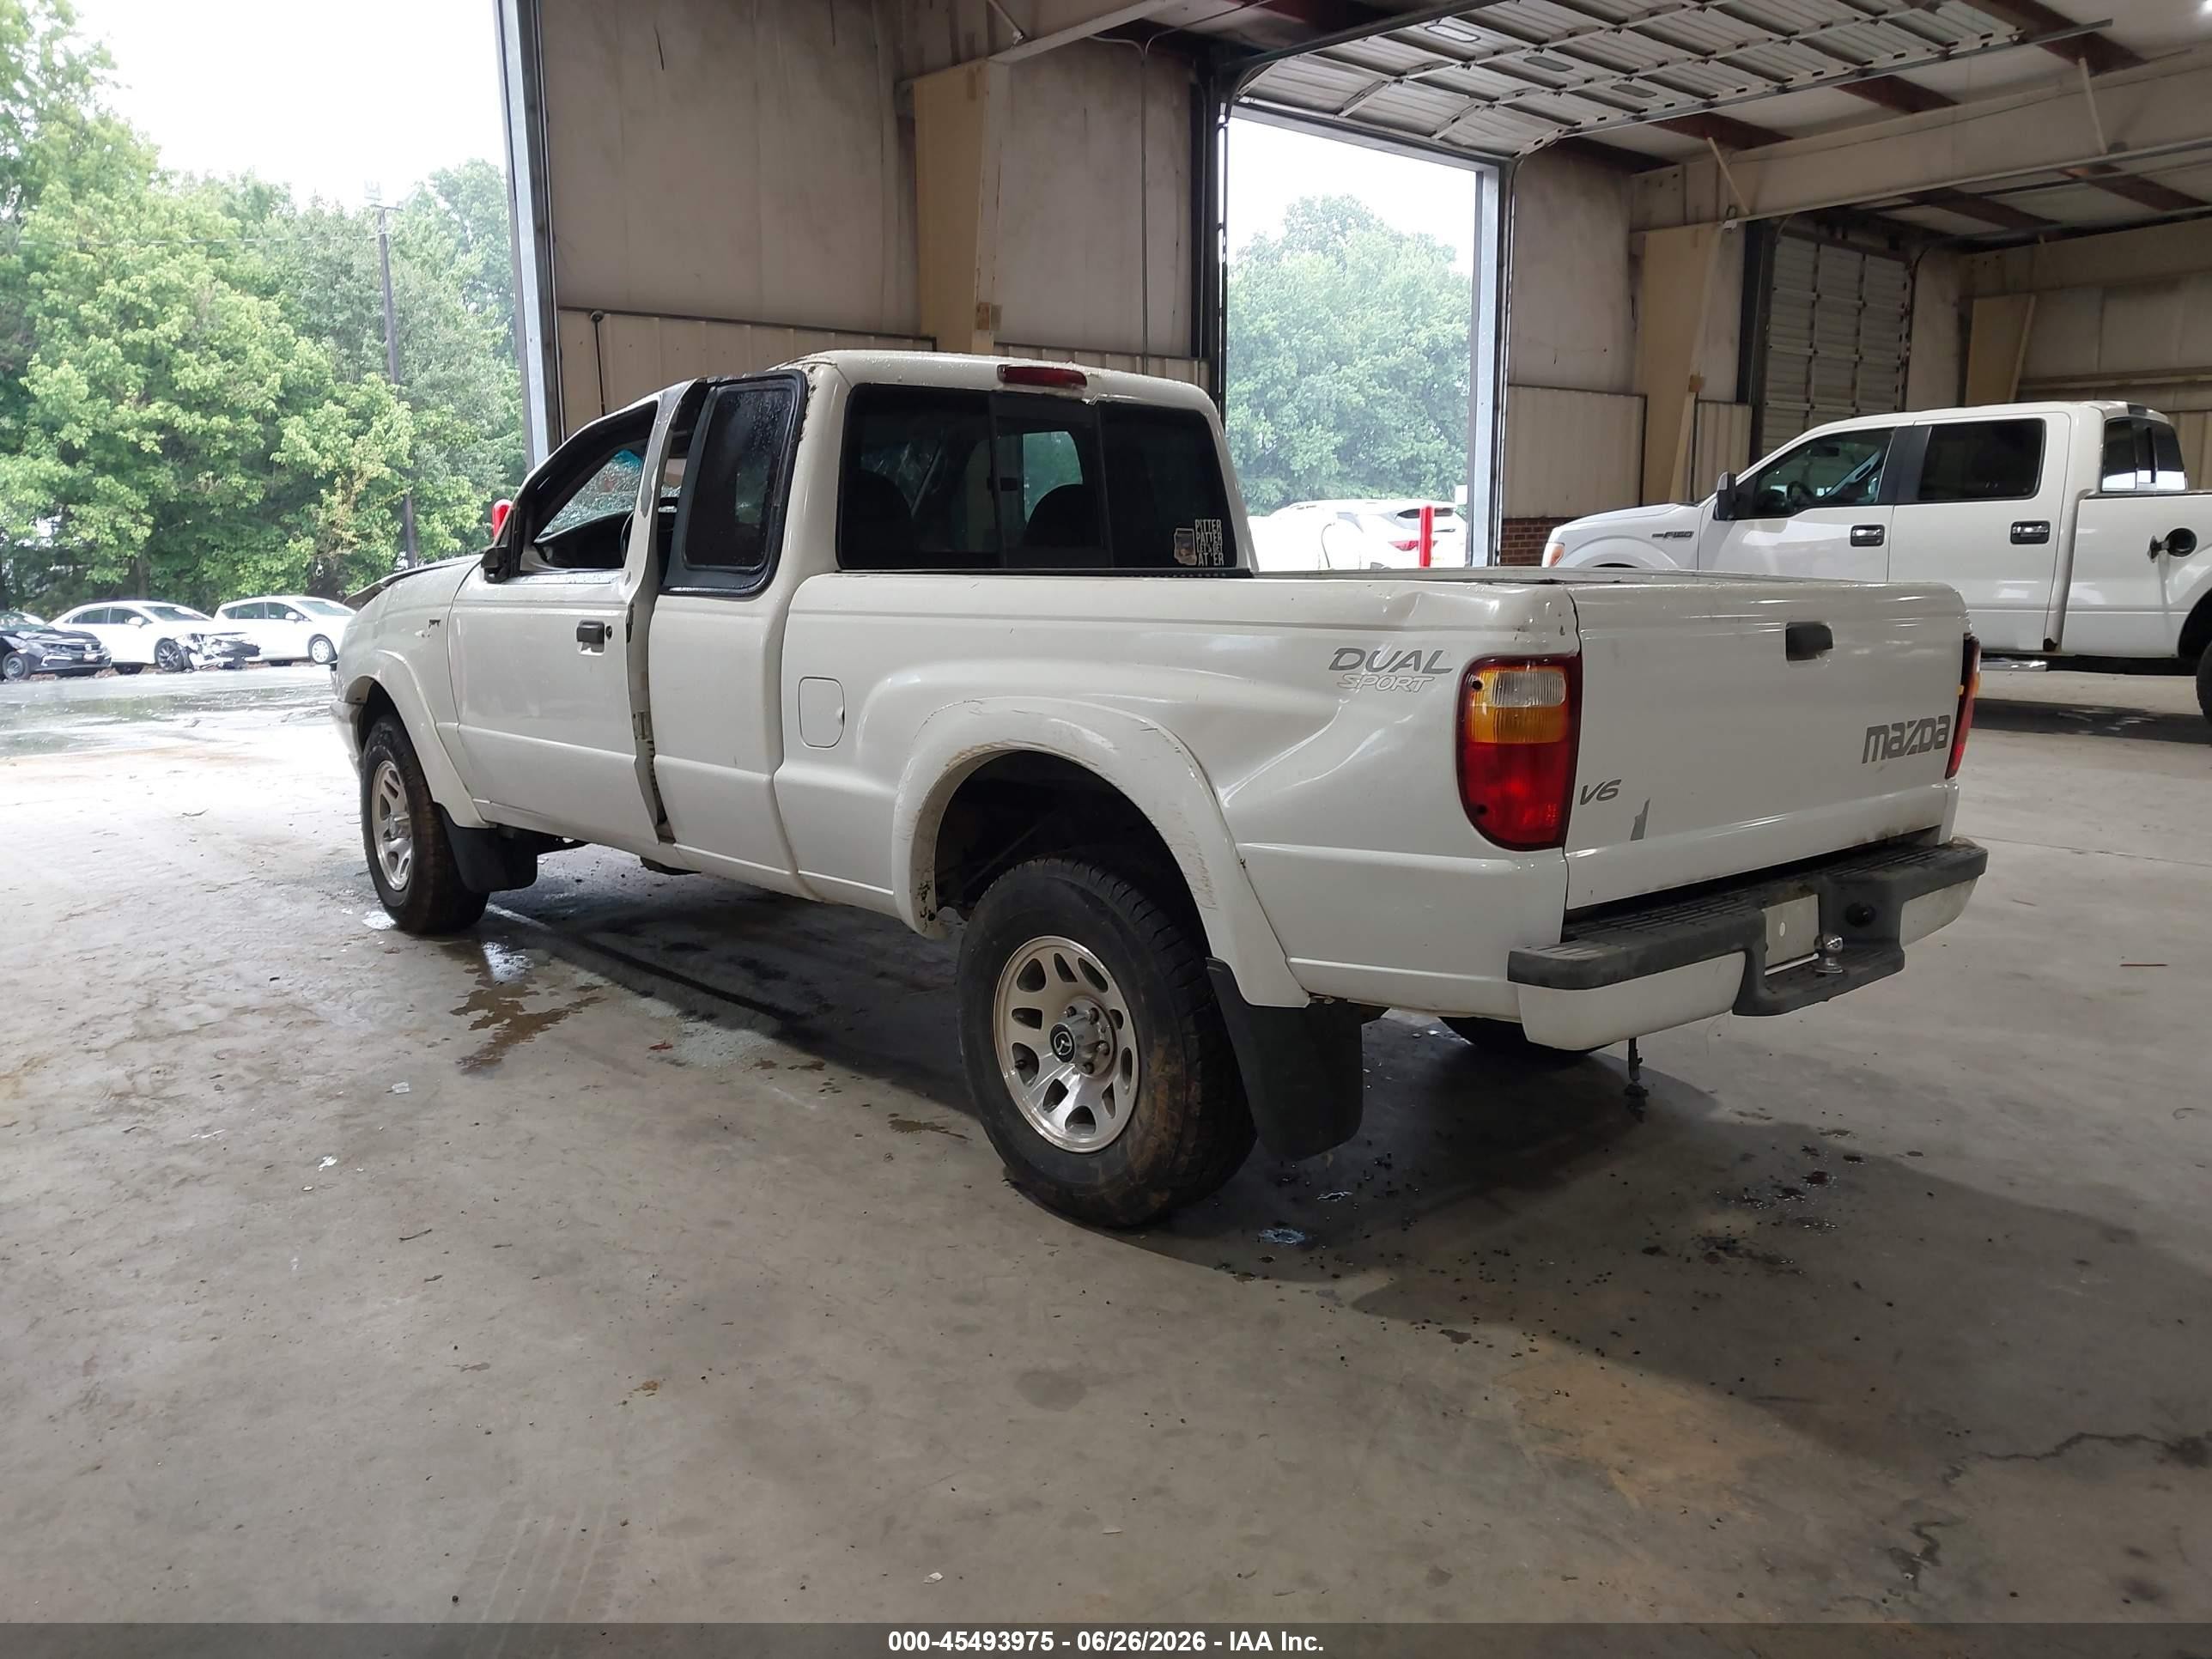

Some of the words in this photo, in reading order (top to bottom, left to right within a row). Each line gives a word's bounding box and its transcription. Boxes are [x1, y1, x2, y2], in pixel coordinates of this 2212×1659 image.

[1195, 519, 1222, 532] PITTER
[1196, 532, 1223, 544] PATTER
[1198, 552, 1209, 567] AT
[1328, 647, 1454, 674] DUAL
[1337, 673, 1435, 693] SPORT
[1580, 779, 1622, 805] V6
